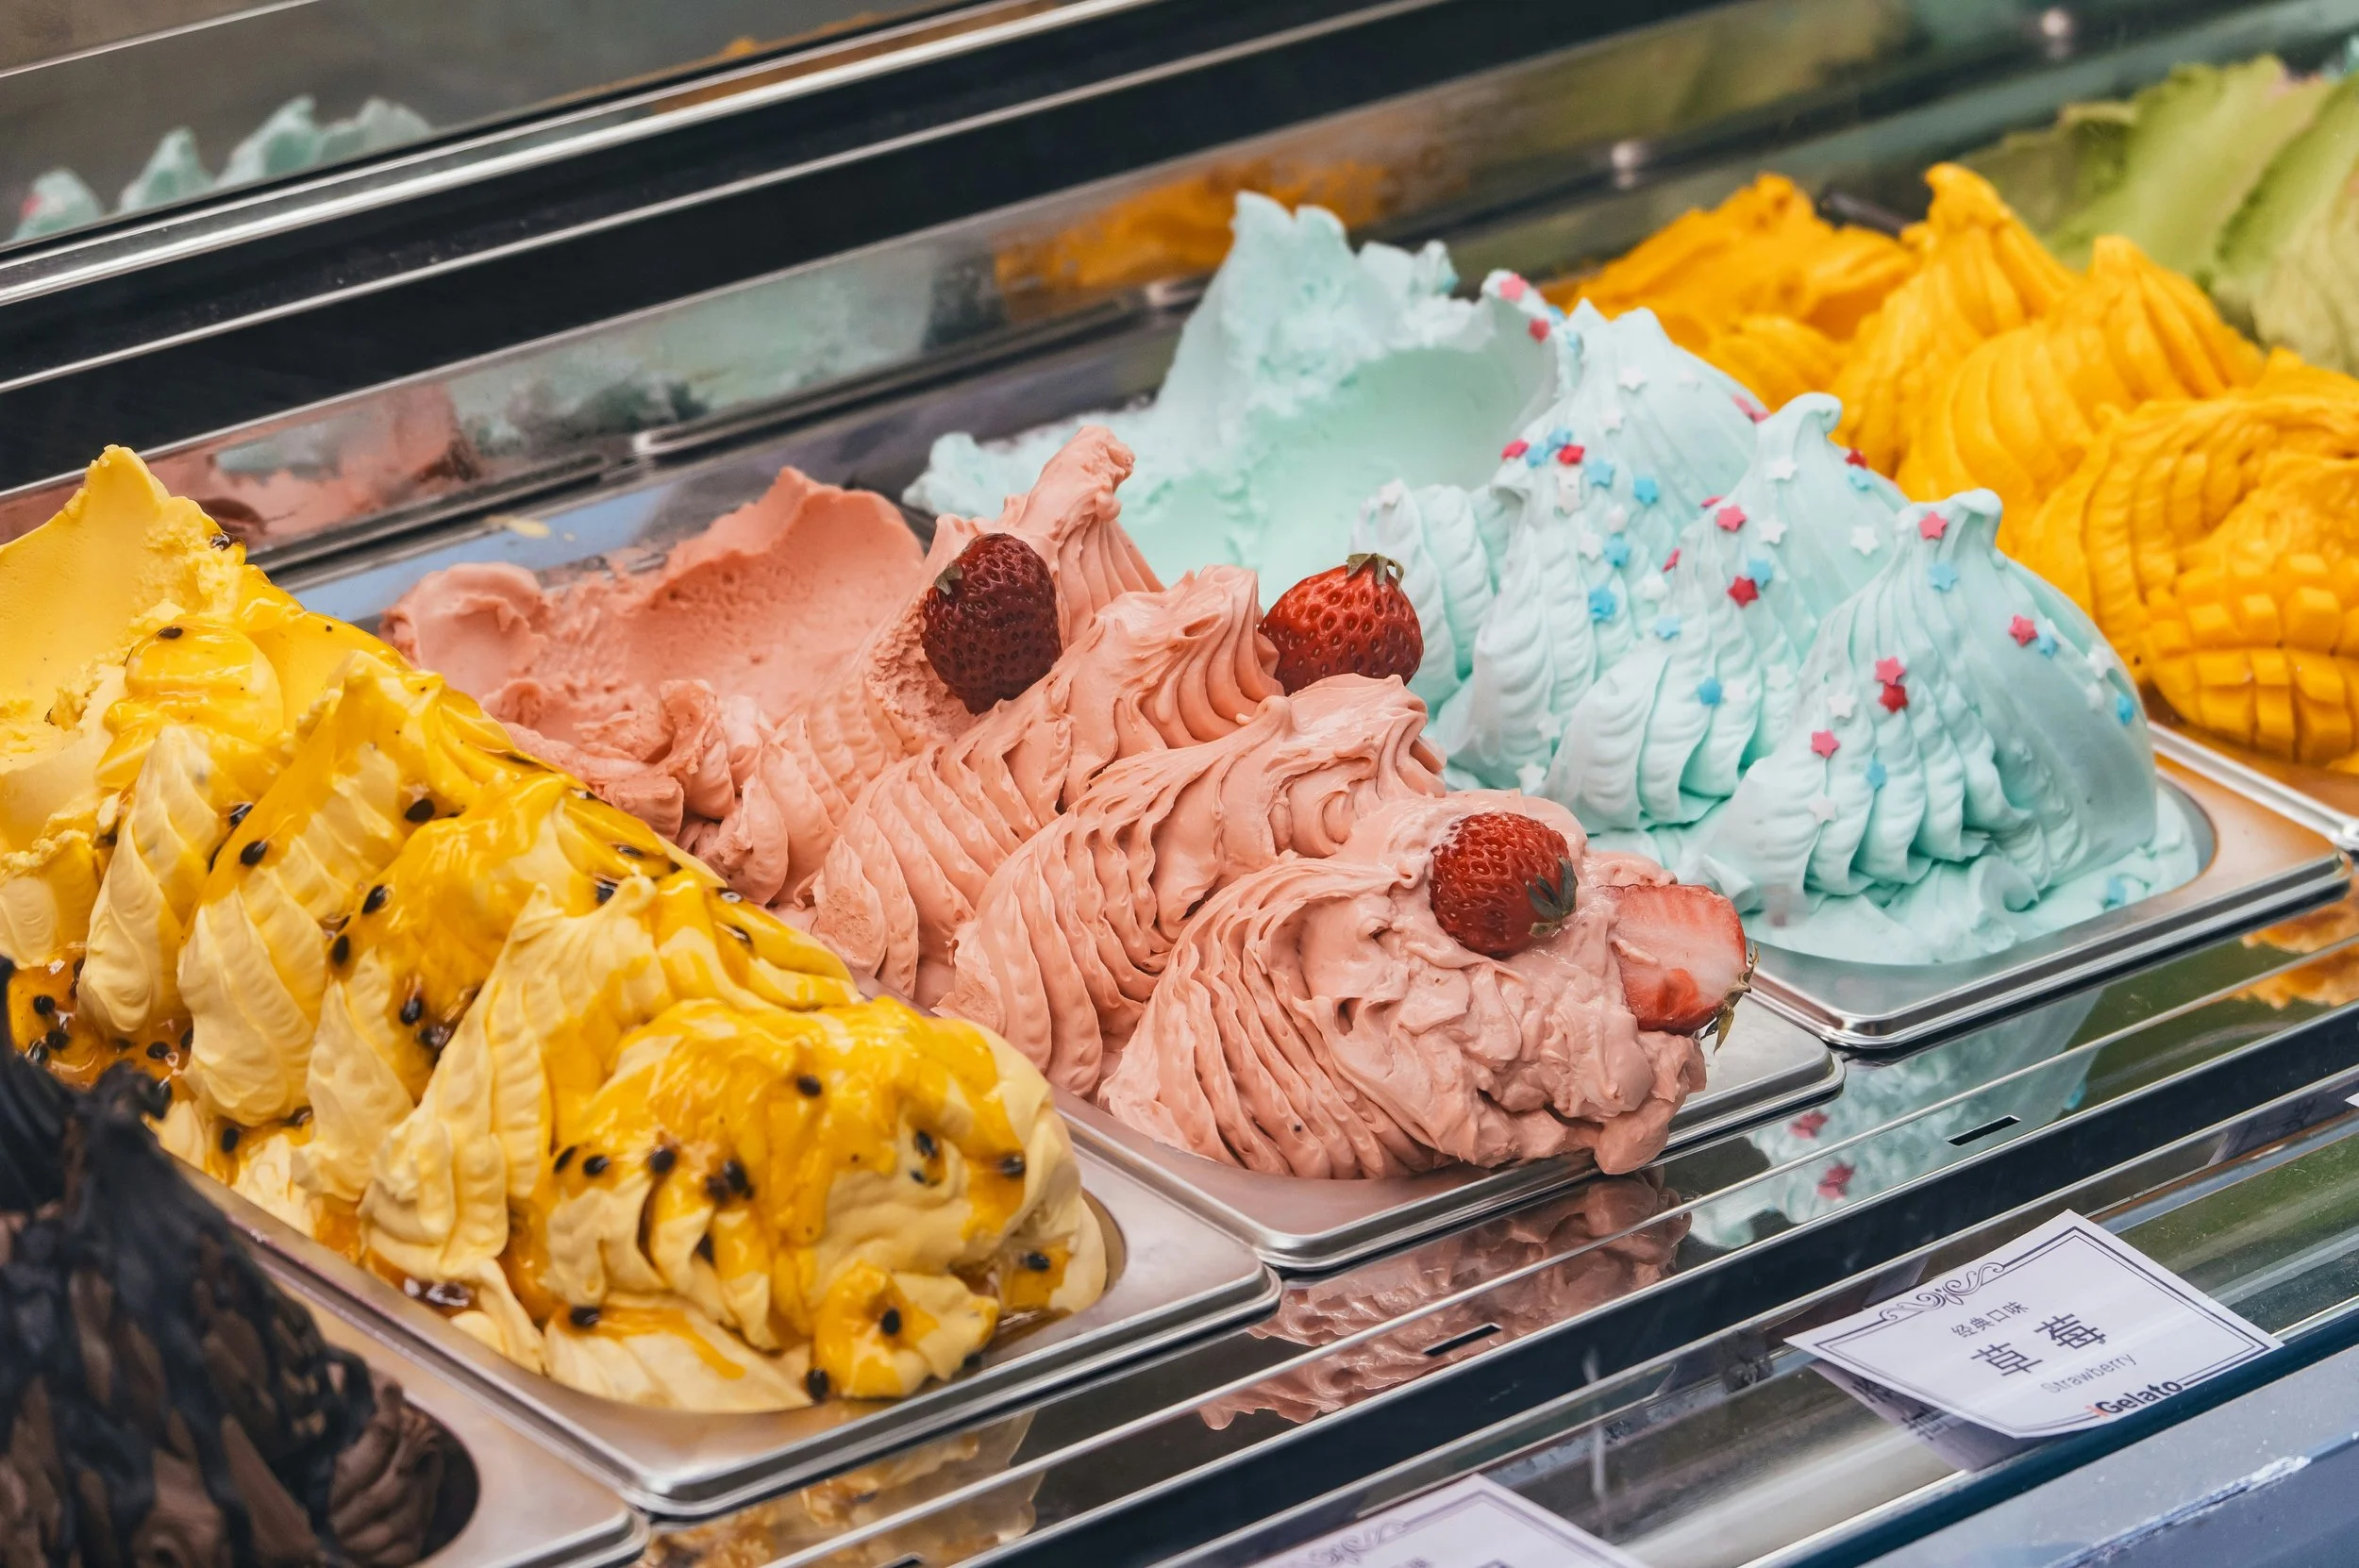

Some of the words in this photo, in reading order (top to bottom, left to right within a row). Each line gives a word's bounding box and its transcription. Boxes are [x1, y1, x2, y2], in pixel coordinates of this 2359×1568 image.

[1951, 1301, 2029, 1338] 经典口味
[1971, 1314, 2106, 1376] 草莓
[2041, 1354, 2136, 1394] Strawberry
[2084, 1380, 2183, 1417] iGelato
